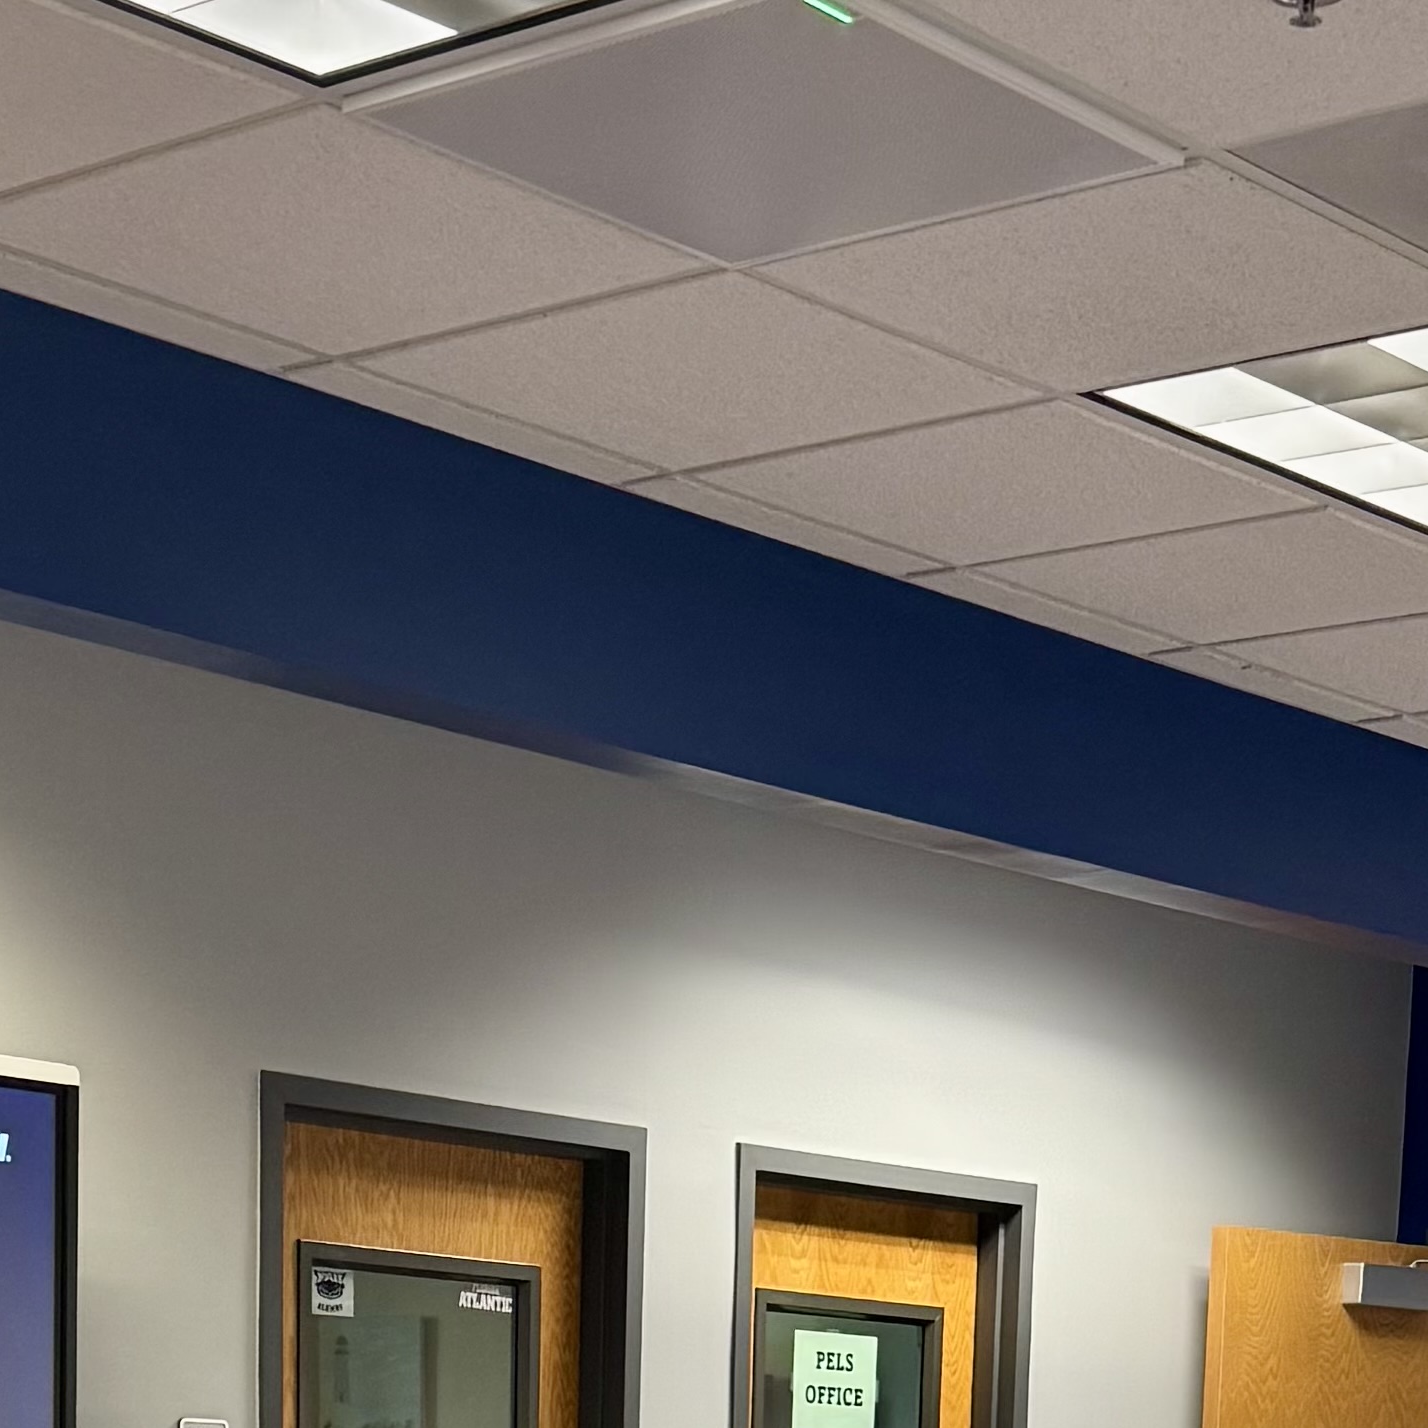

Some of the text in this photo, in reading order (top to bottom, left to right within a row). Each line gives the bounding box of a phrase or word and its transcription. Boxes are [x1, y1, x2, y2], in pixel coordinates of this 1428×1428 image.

[459, 1291, 513, 1313] ATLANTIC
[815, 1351, 854, 1372] PELS
[804, 1385, 864, 1407] OFFICE
